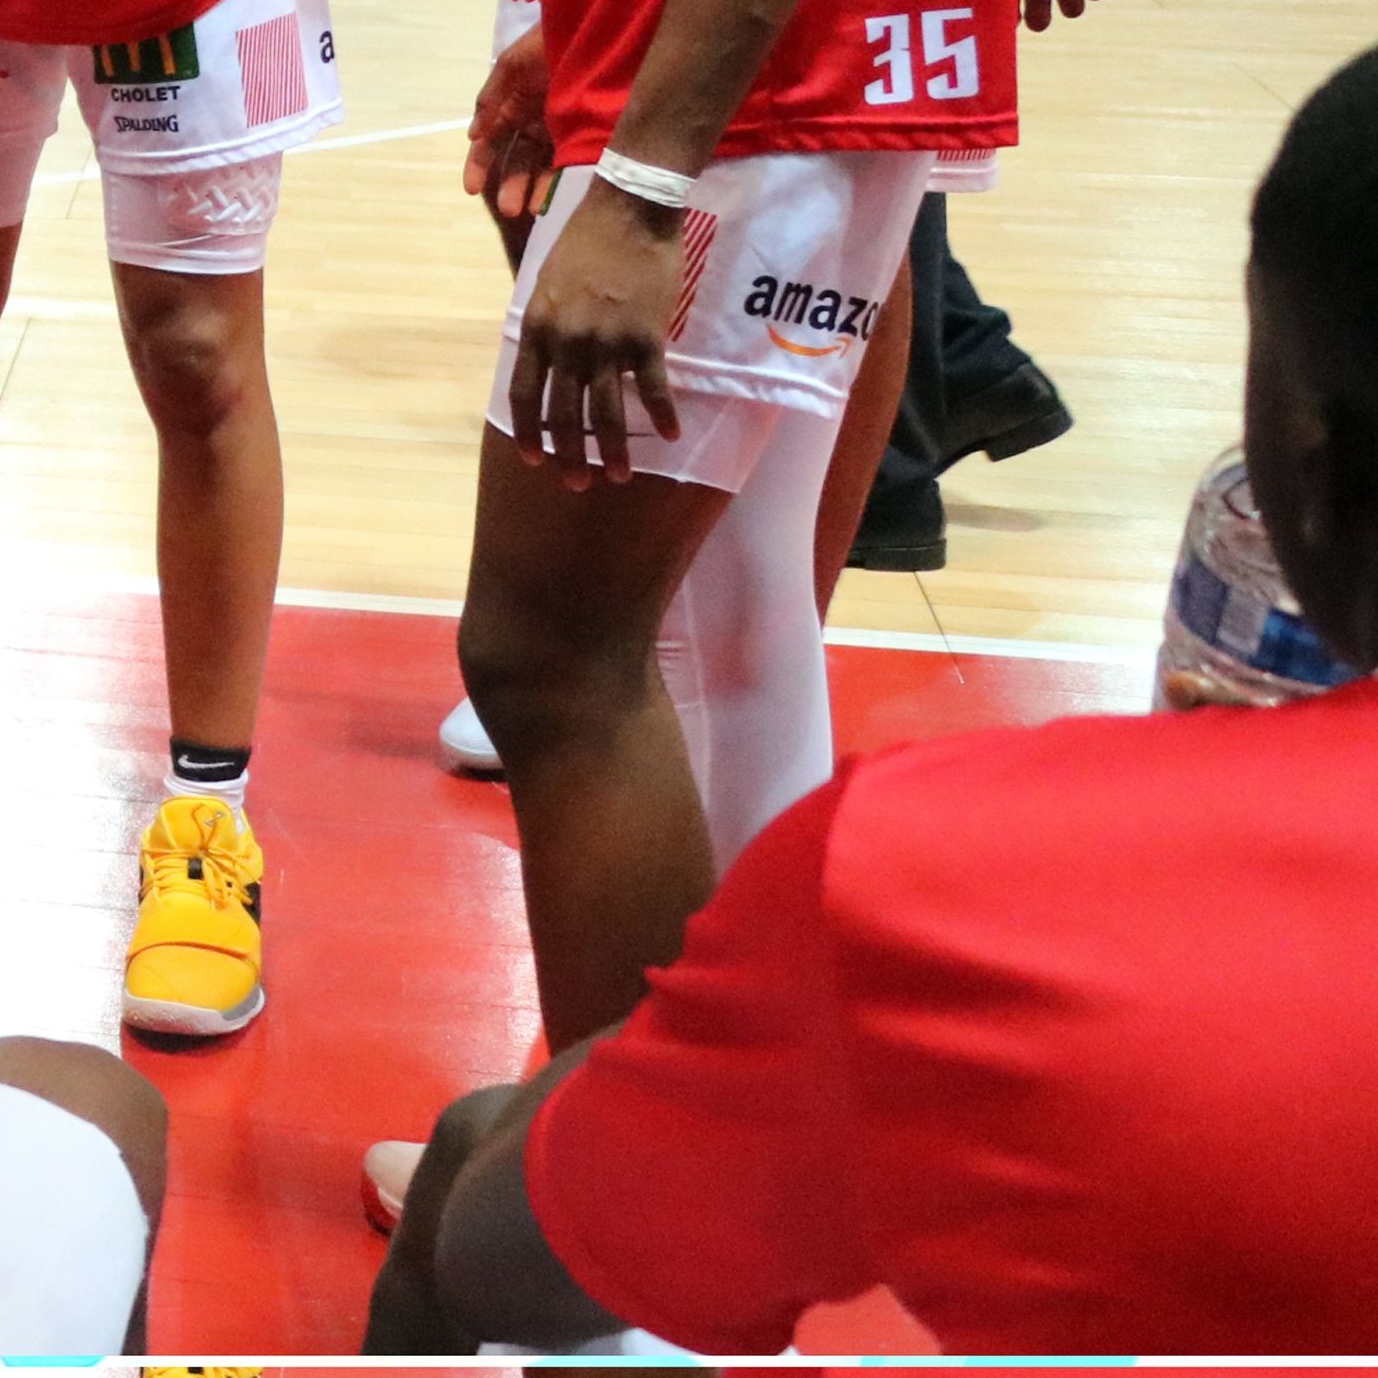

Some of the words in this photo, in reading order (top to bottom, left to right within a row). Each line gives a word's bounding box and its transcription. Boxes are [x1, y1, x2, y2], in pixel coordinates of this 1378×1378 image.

[864, 8, 980, 105] 35
[111, 85, 181, 103] CHOLET
[114, 114, 178, 132] SPALDING
